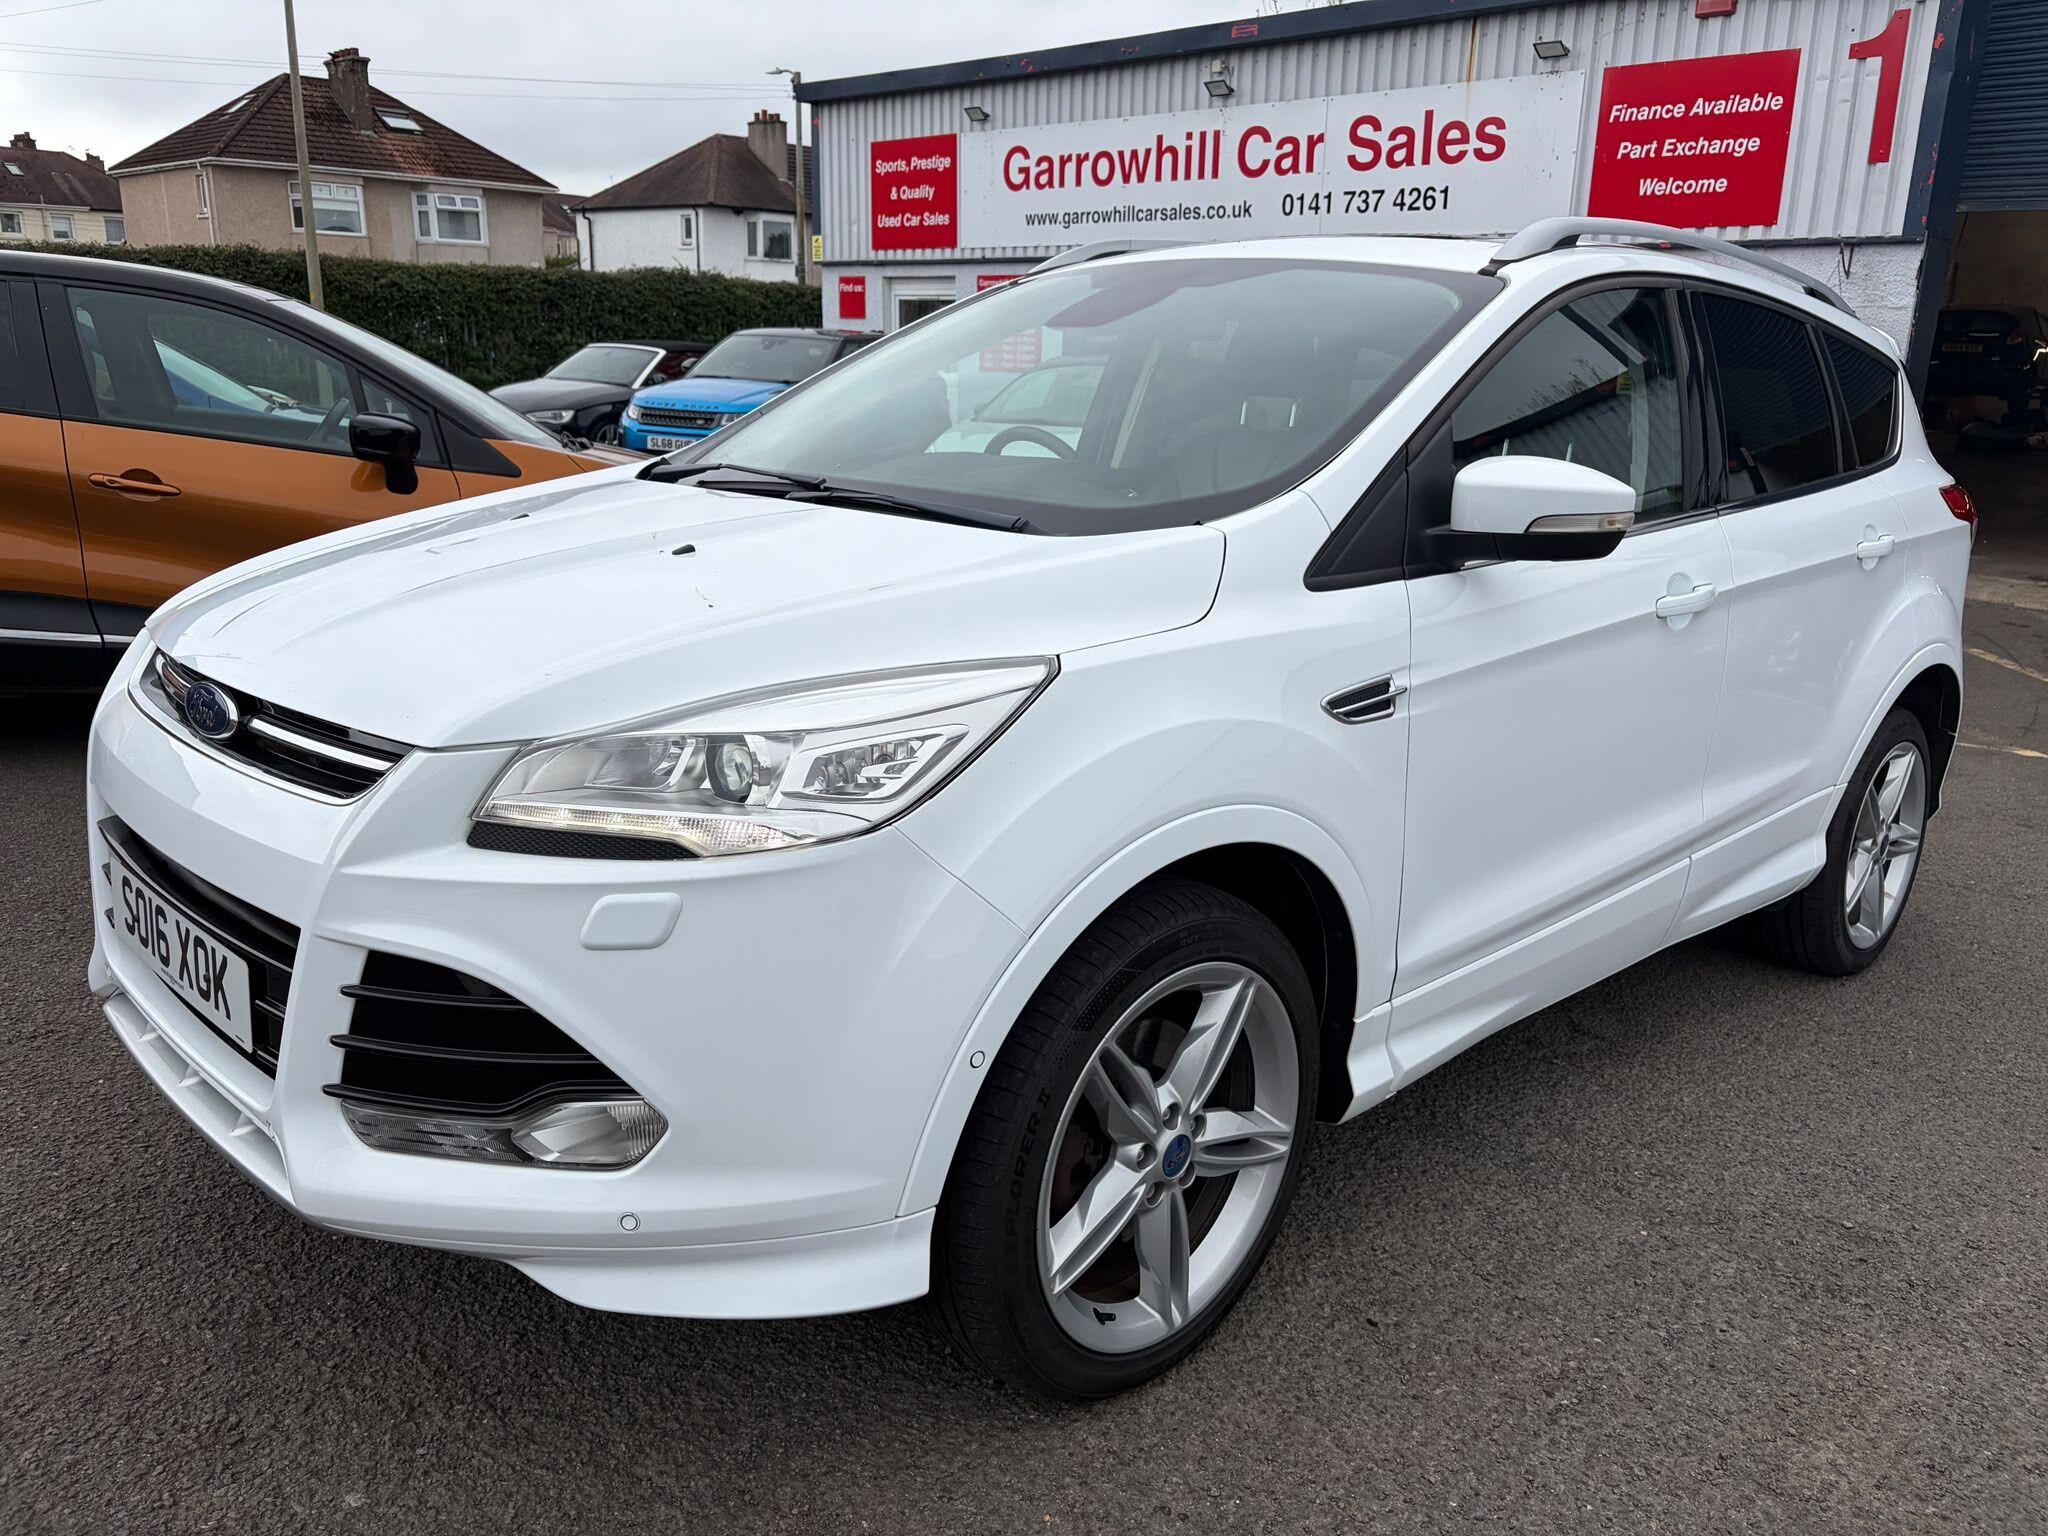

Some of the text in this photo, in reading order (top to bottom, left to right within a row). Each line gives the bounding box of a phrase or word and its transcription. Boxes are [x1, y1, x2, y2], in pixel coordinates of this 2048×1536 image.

[1849, 9, 1911, 164] 1
[1609, 92, 1784, 123] Finance Available
[1003, 110, 1506, 192] Garrowhill Car Sales
[1616, 136, 1761, 160] Part Exchange
[875, 155, 952, 177] Sports, Prestige
[890, 184, 935, 202] & Quality
[1639, 177, 1729, 196] Welcome
[1281, 186, 1449, 217] 0141 737 4261
[877, 212, 951, 228] Used Car Sales
[1024, 200, 1253, 230] www.garrowhillcarsales.co.uk
[839, 283, 853, 292] Find
[650, 437, 673, 449] SL68
